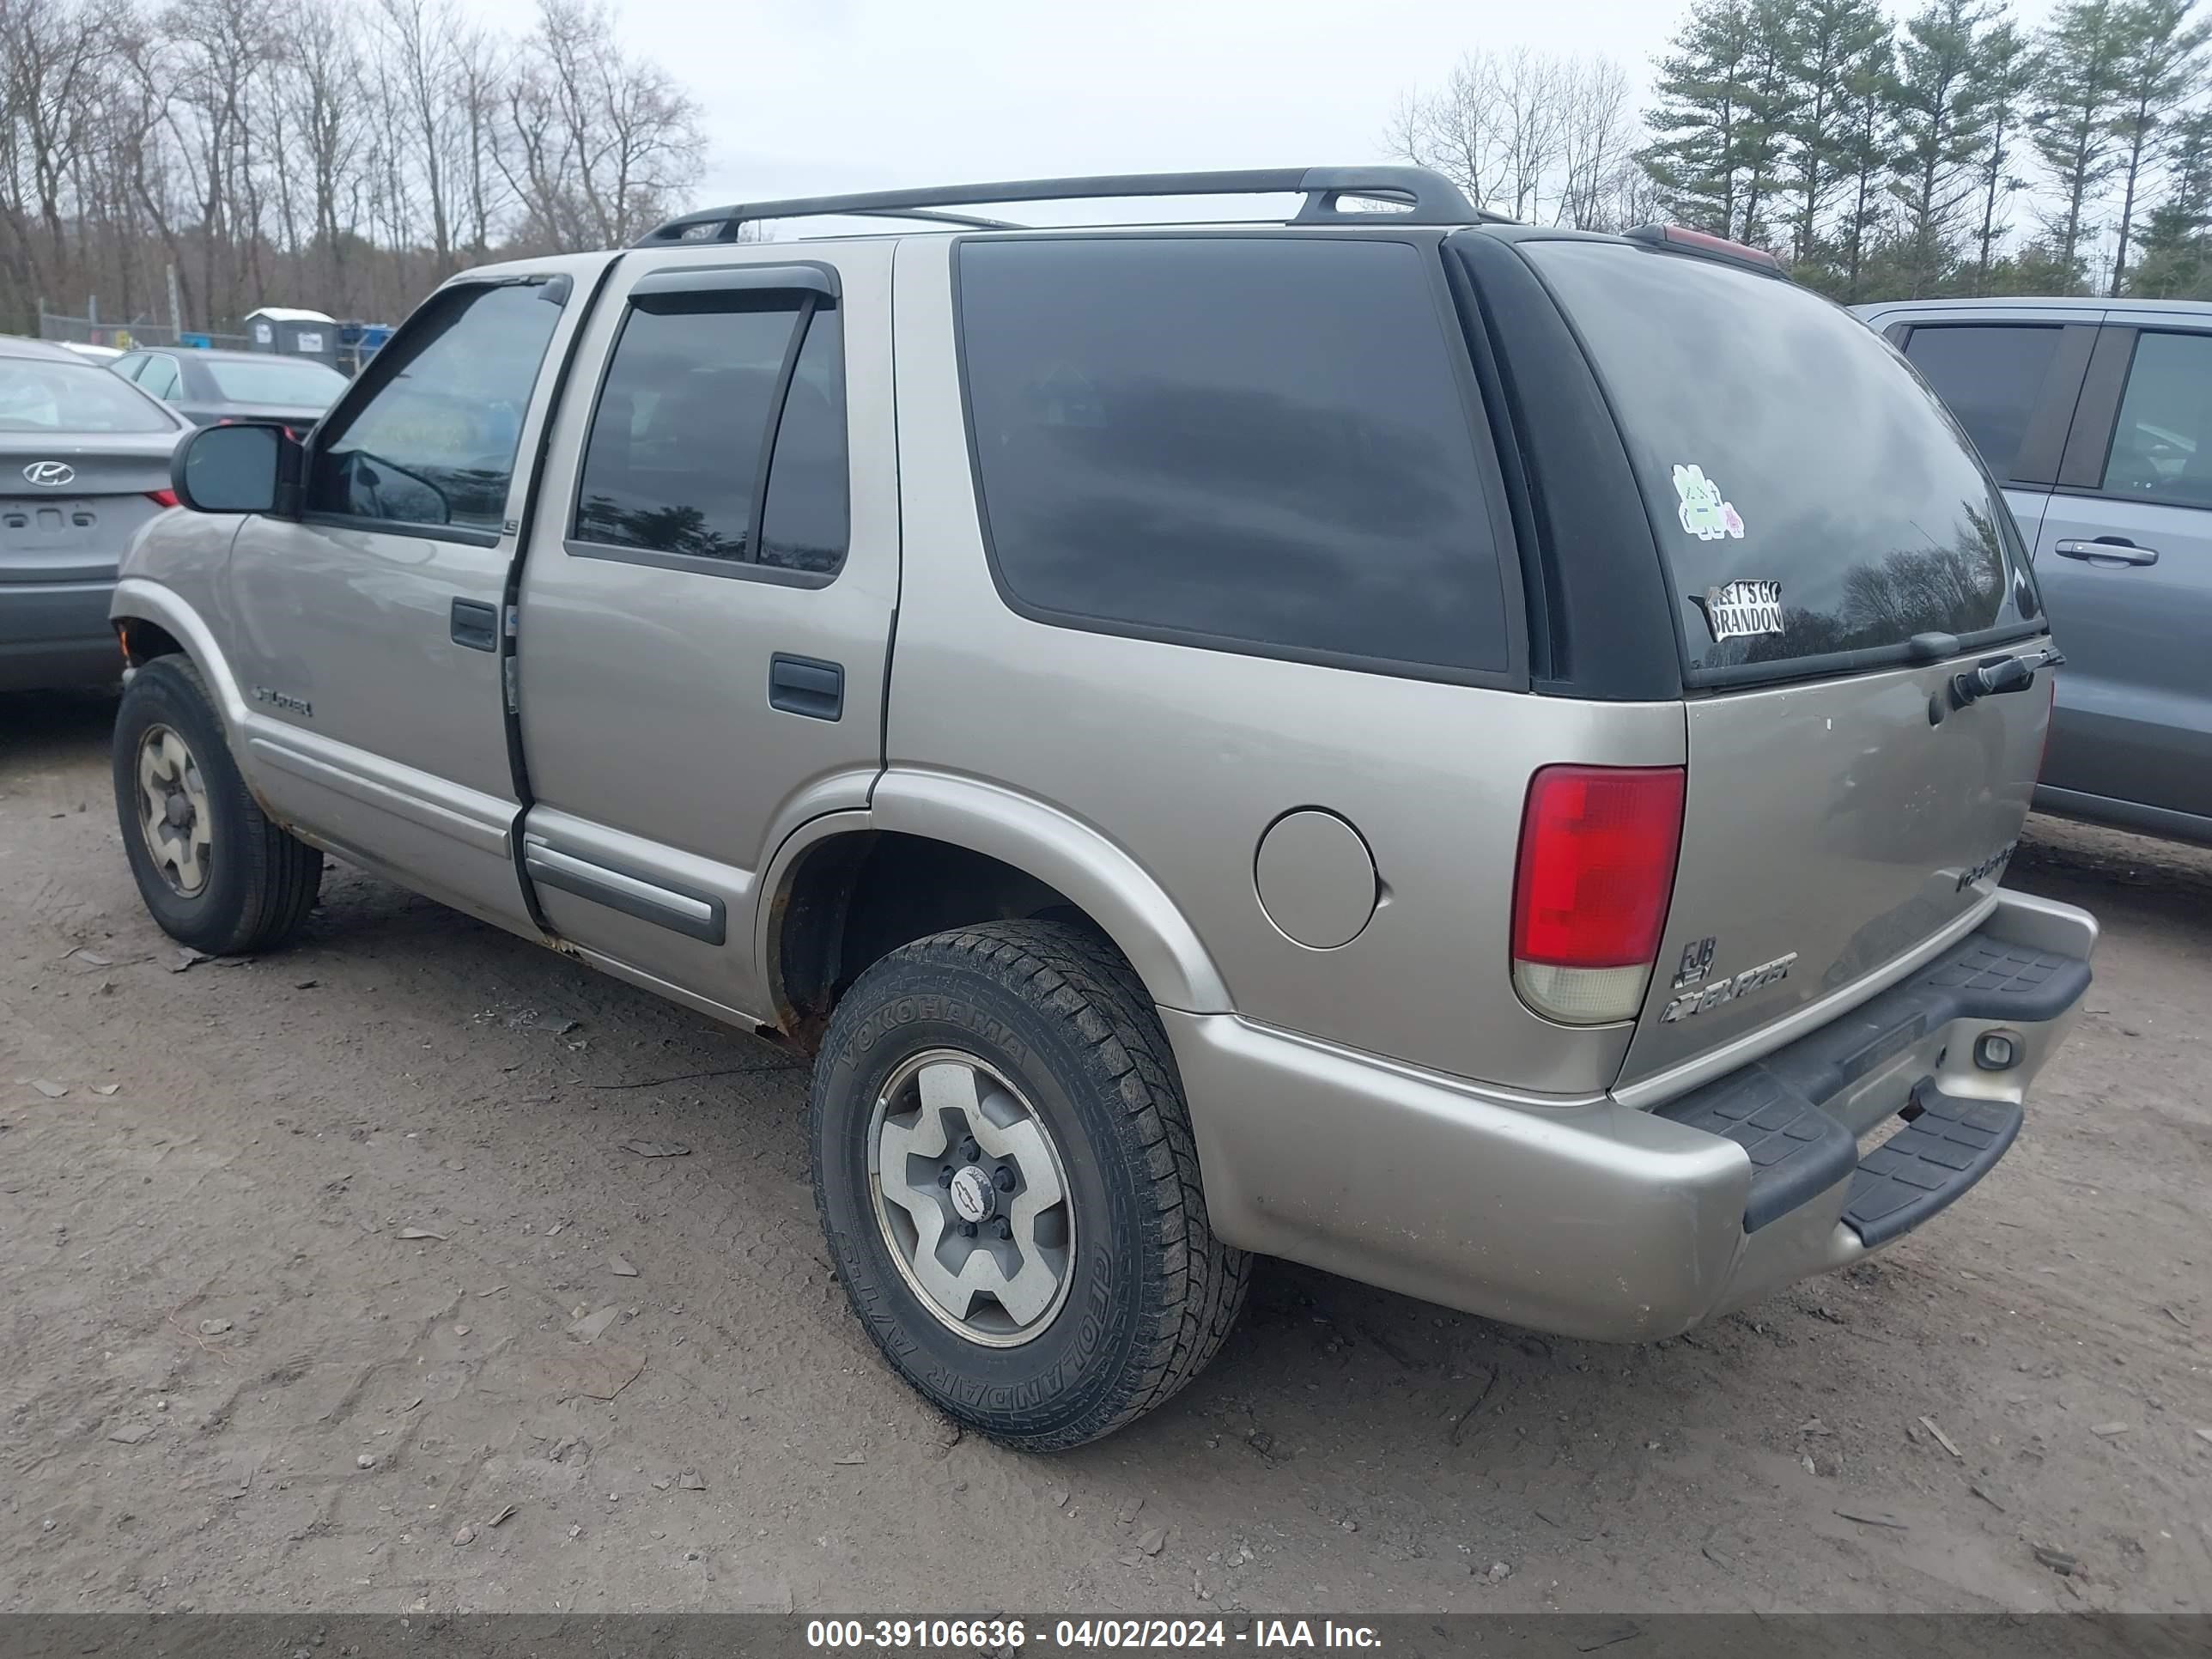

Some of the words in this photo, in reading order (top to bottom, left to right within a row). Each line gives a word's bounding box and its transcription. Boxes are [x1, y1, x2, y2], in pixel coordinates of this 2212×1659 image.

[1698, 951, 1798, 1013] BLAZER
[841, 993, 1030, 1072] YOKOHAMA
[927, 1244, 1111, 1411] GEOLANDAR
